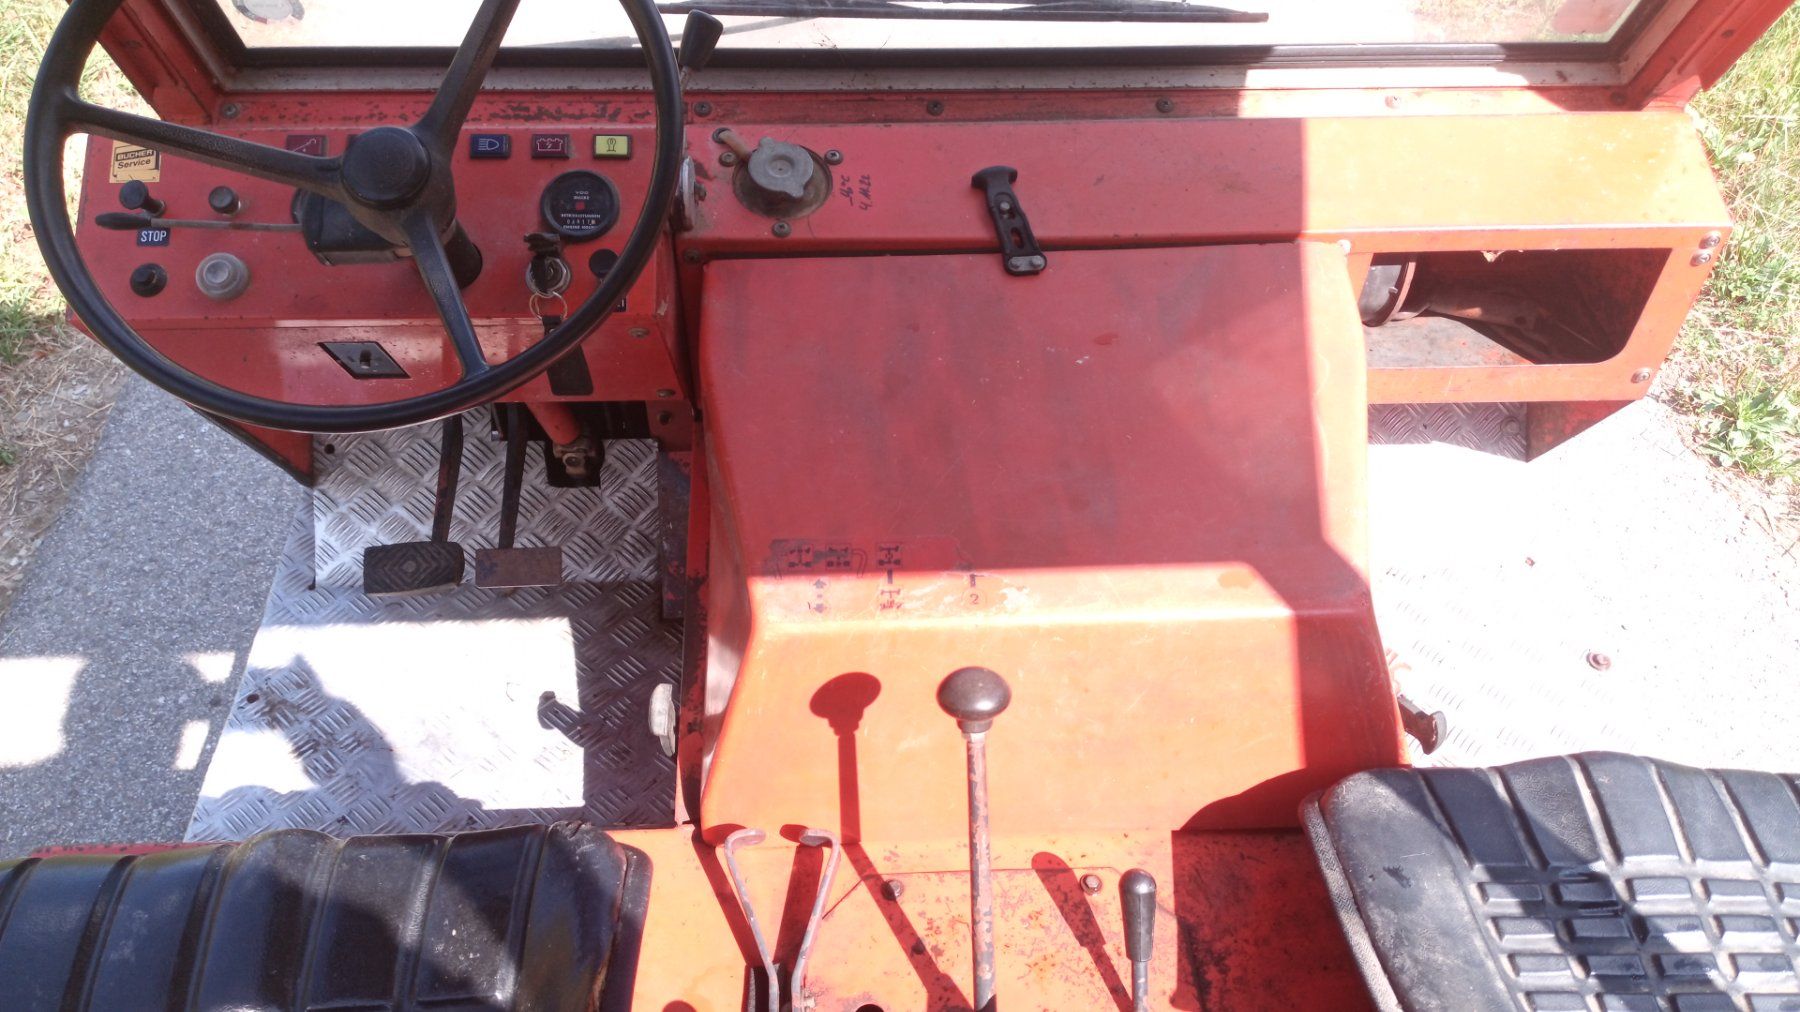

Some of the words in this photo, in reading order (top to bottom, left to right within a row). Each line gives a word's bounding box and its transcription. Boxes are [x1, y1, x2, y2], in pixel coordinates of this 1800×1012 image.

[117, 150, 153, 160] BUCHER
[117, 159, 151, 169] Service
[140, 230, 167, 242] STOP
